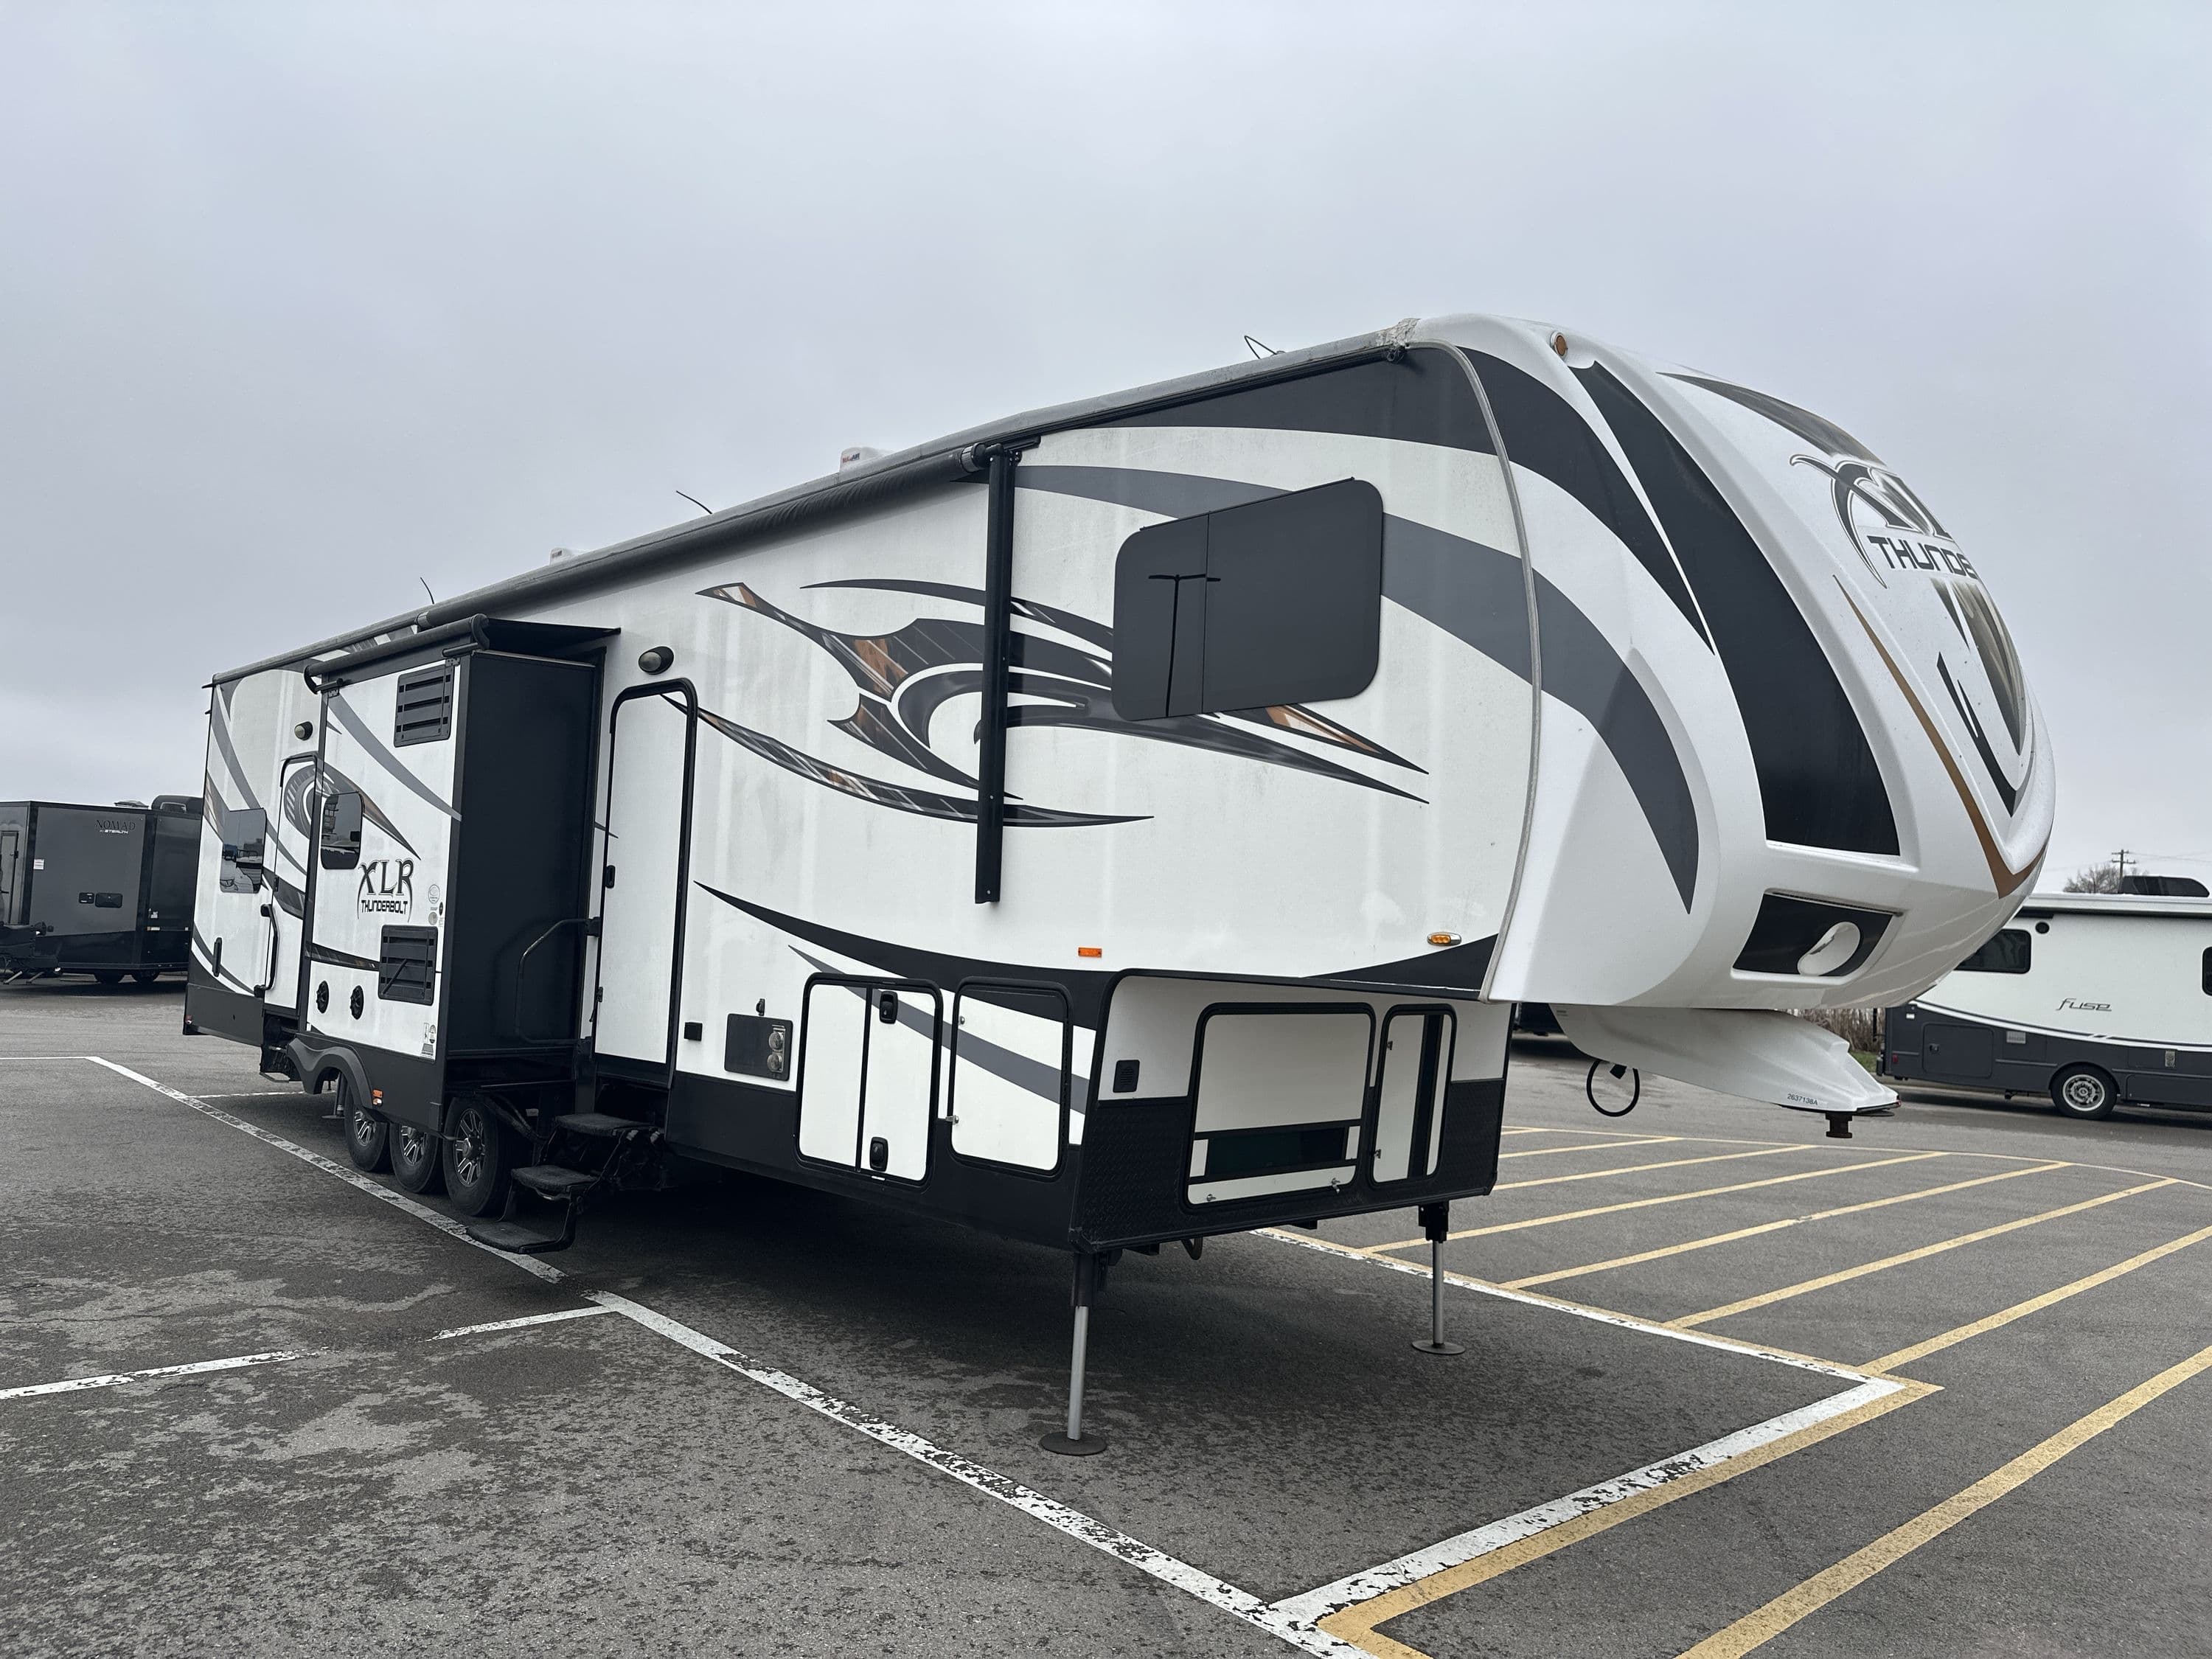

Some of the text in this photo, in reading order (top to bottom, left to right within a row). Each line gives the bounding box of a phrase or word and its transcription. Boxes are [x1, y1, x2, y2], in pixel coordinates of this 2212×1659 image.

[96, 819, 136, 830] NOMAD
[358, 858, 414, 922] XLR
[361, 900, 408, 915] THUNDERBOLT
[1787, 1093, 1818, 1105] 2637138A
